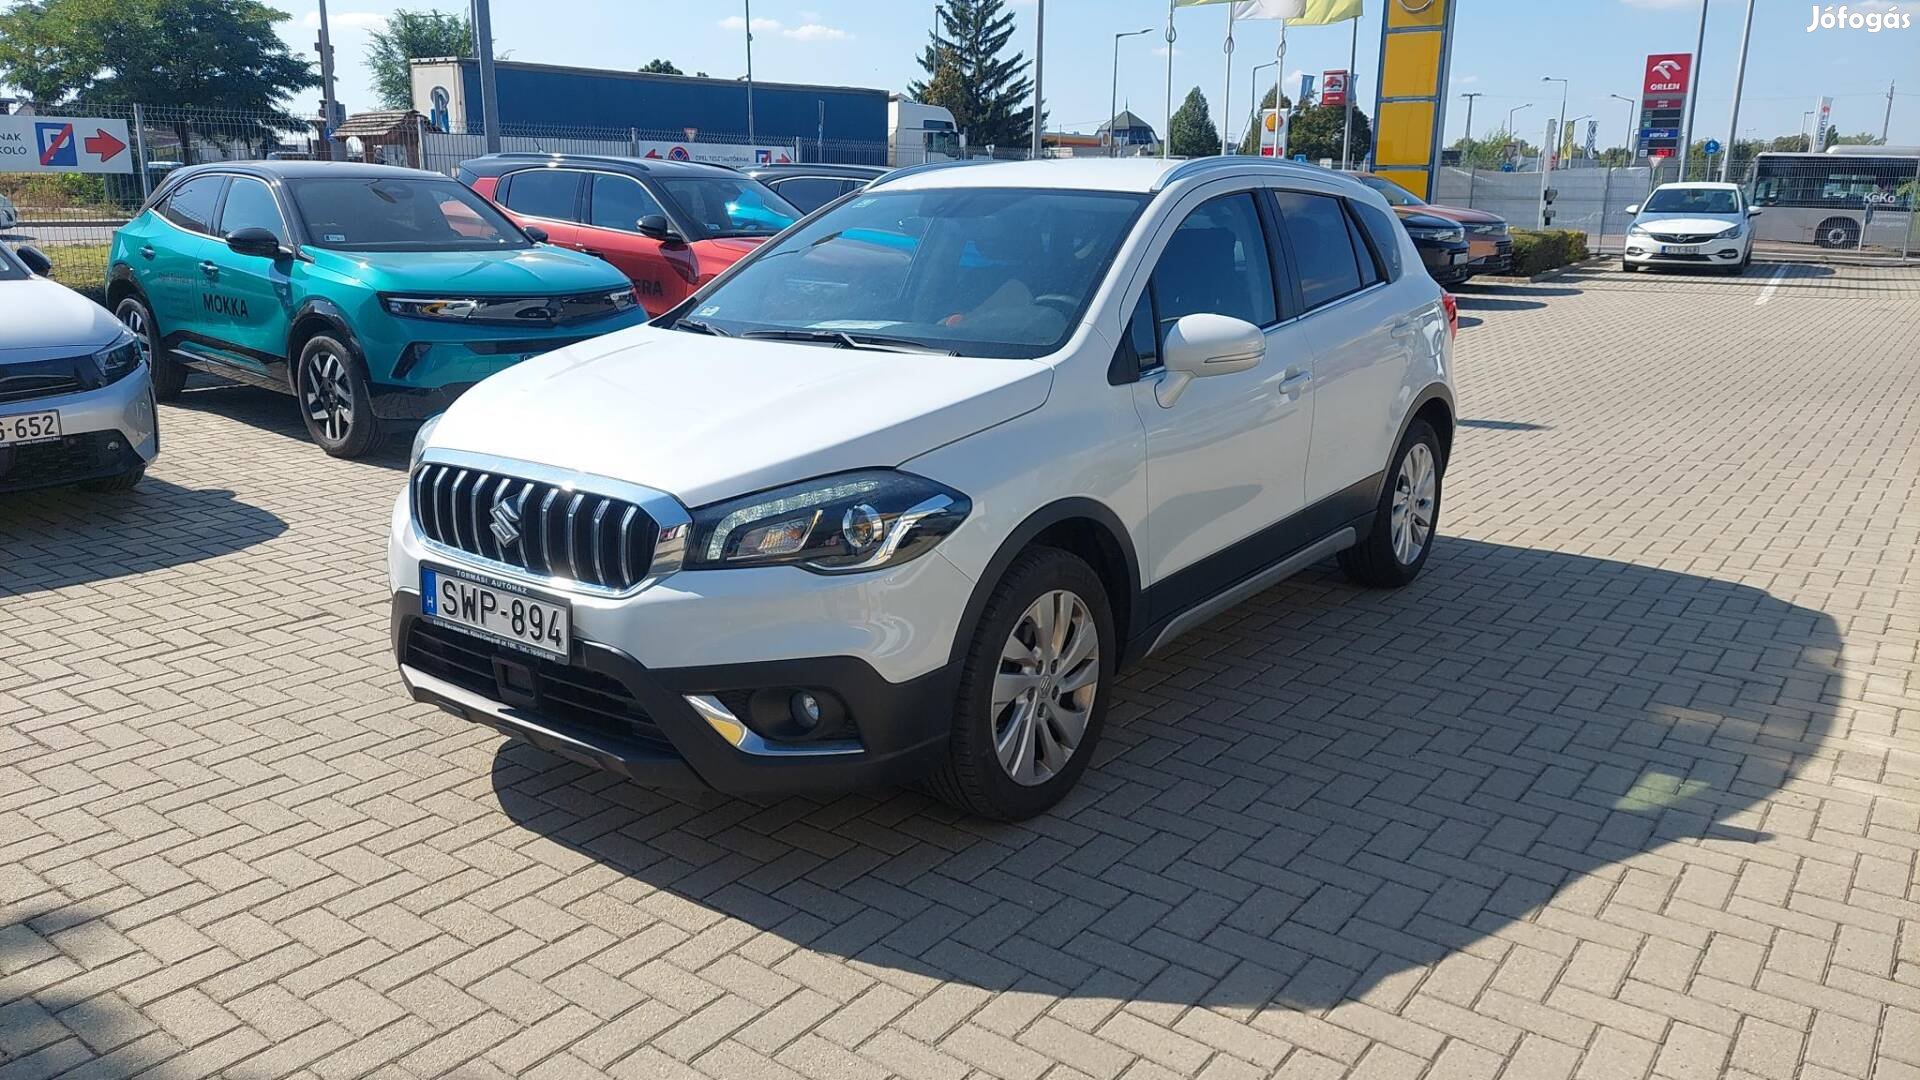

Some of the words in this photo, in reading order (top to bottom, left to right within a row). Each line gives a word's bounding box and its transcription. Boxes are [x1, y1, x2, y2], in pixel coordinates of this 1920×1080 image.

[1650, 83, 1680, 91] ORLEN
[1864, 192, 1896, 203] KeKo
[202, 293, 248, 320] MOKKA
[442, 580, 562, 647] SWP-894
